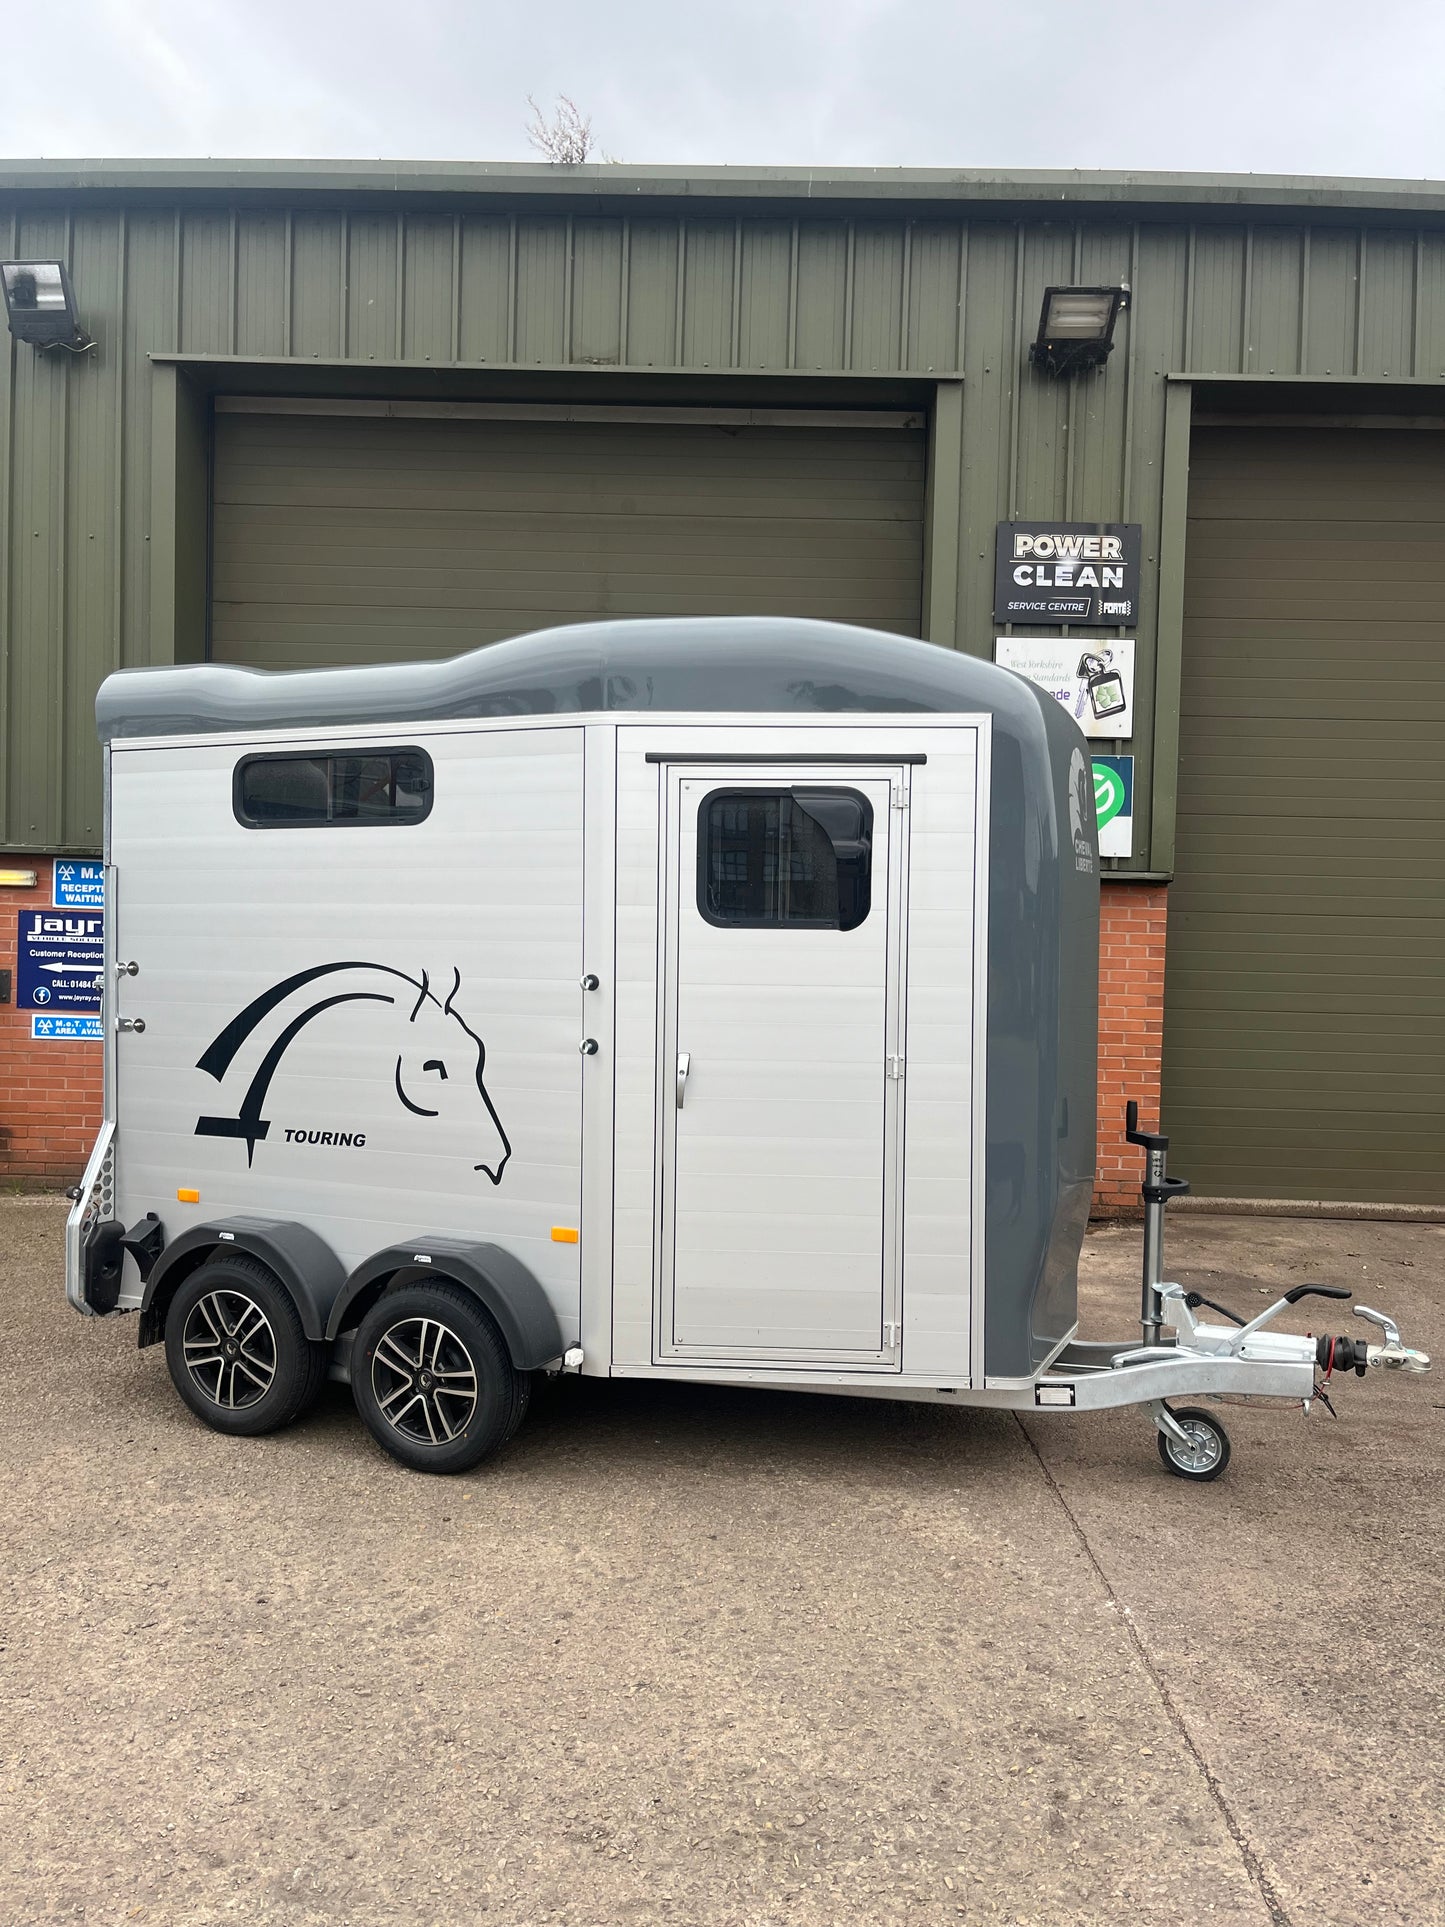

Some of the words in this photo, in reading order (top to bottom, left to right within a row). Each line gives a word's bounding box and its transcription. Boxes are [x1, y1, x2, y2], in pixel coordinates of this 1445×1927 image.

[1015, 534, 1123, 559] POWER
[1013, 566, 1123, 588] CLEAN
[1007, 601, 1046, 611] SERVICE
[1047, 602, 1085, 612] CENTRE
[1010, 659, 1027, 669] West
[1028, 659, 1063, 670] Yorkshire
[1031, 674, 1071, 683] Standards
[1049, 689, 1071, 701] ade
[28, 916, 104, 937] jayr
[30, 950, 65, 958] Customer
[67, 951, 104, 960] Reception
[52, 980, 69, 988] CALL:
[86, 1021, 103, 1029] VIE
[285, 1130, 366, 1147] TOURING
